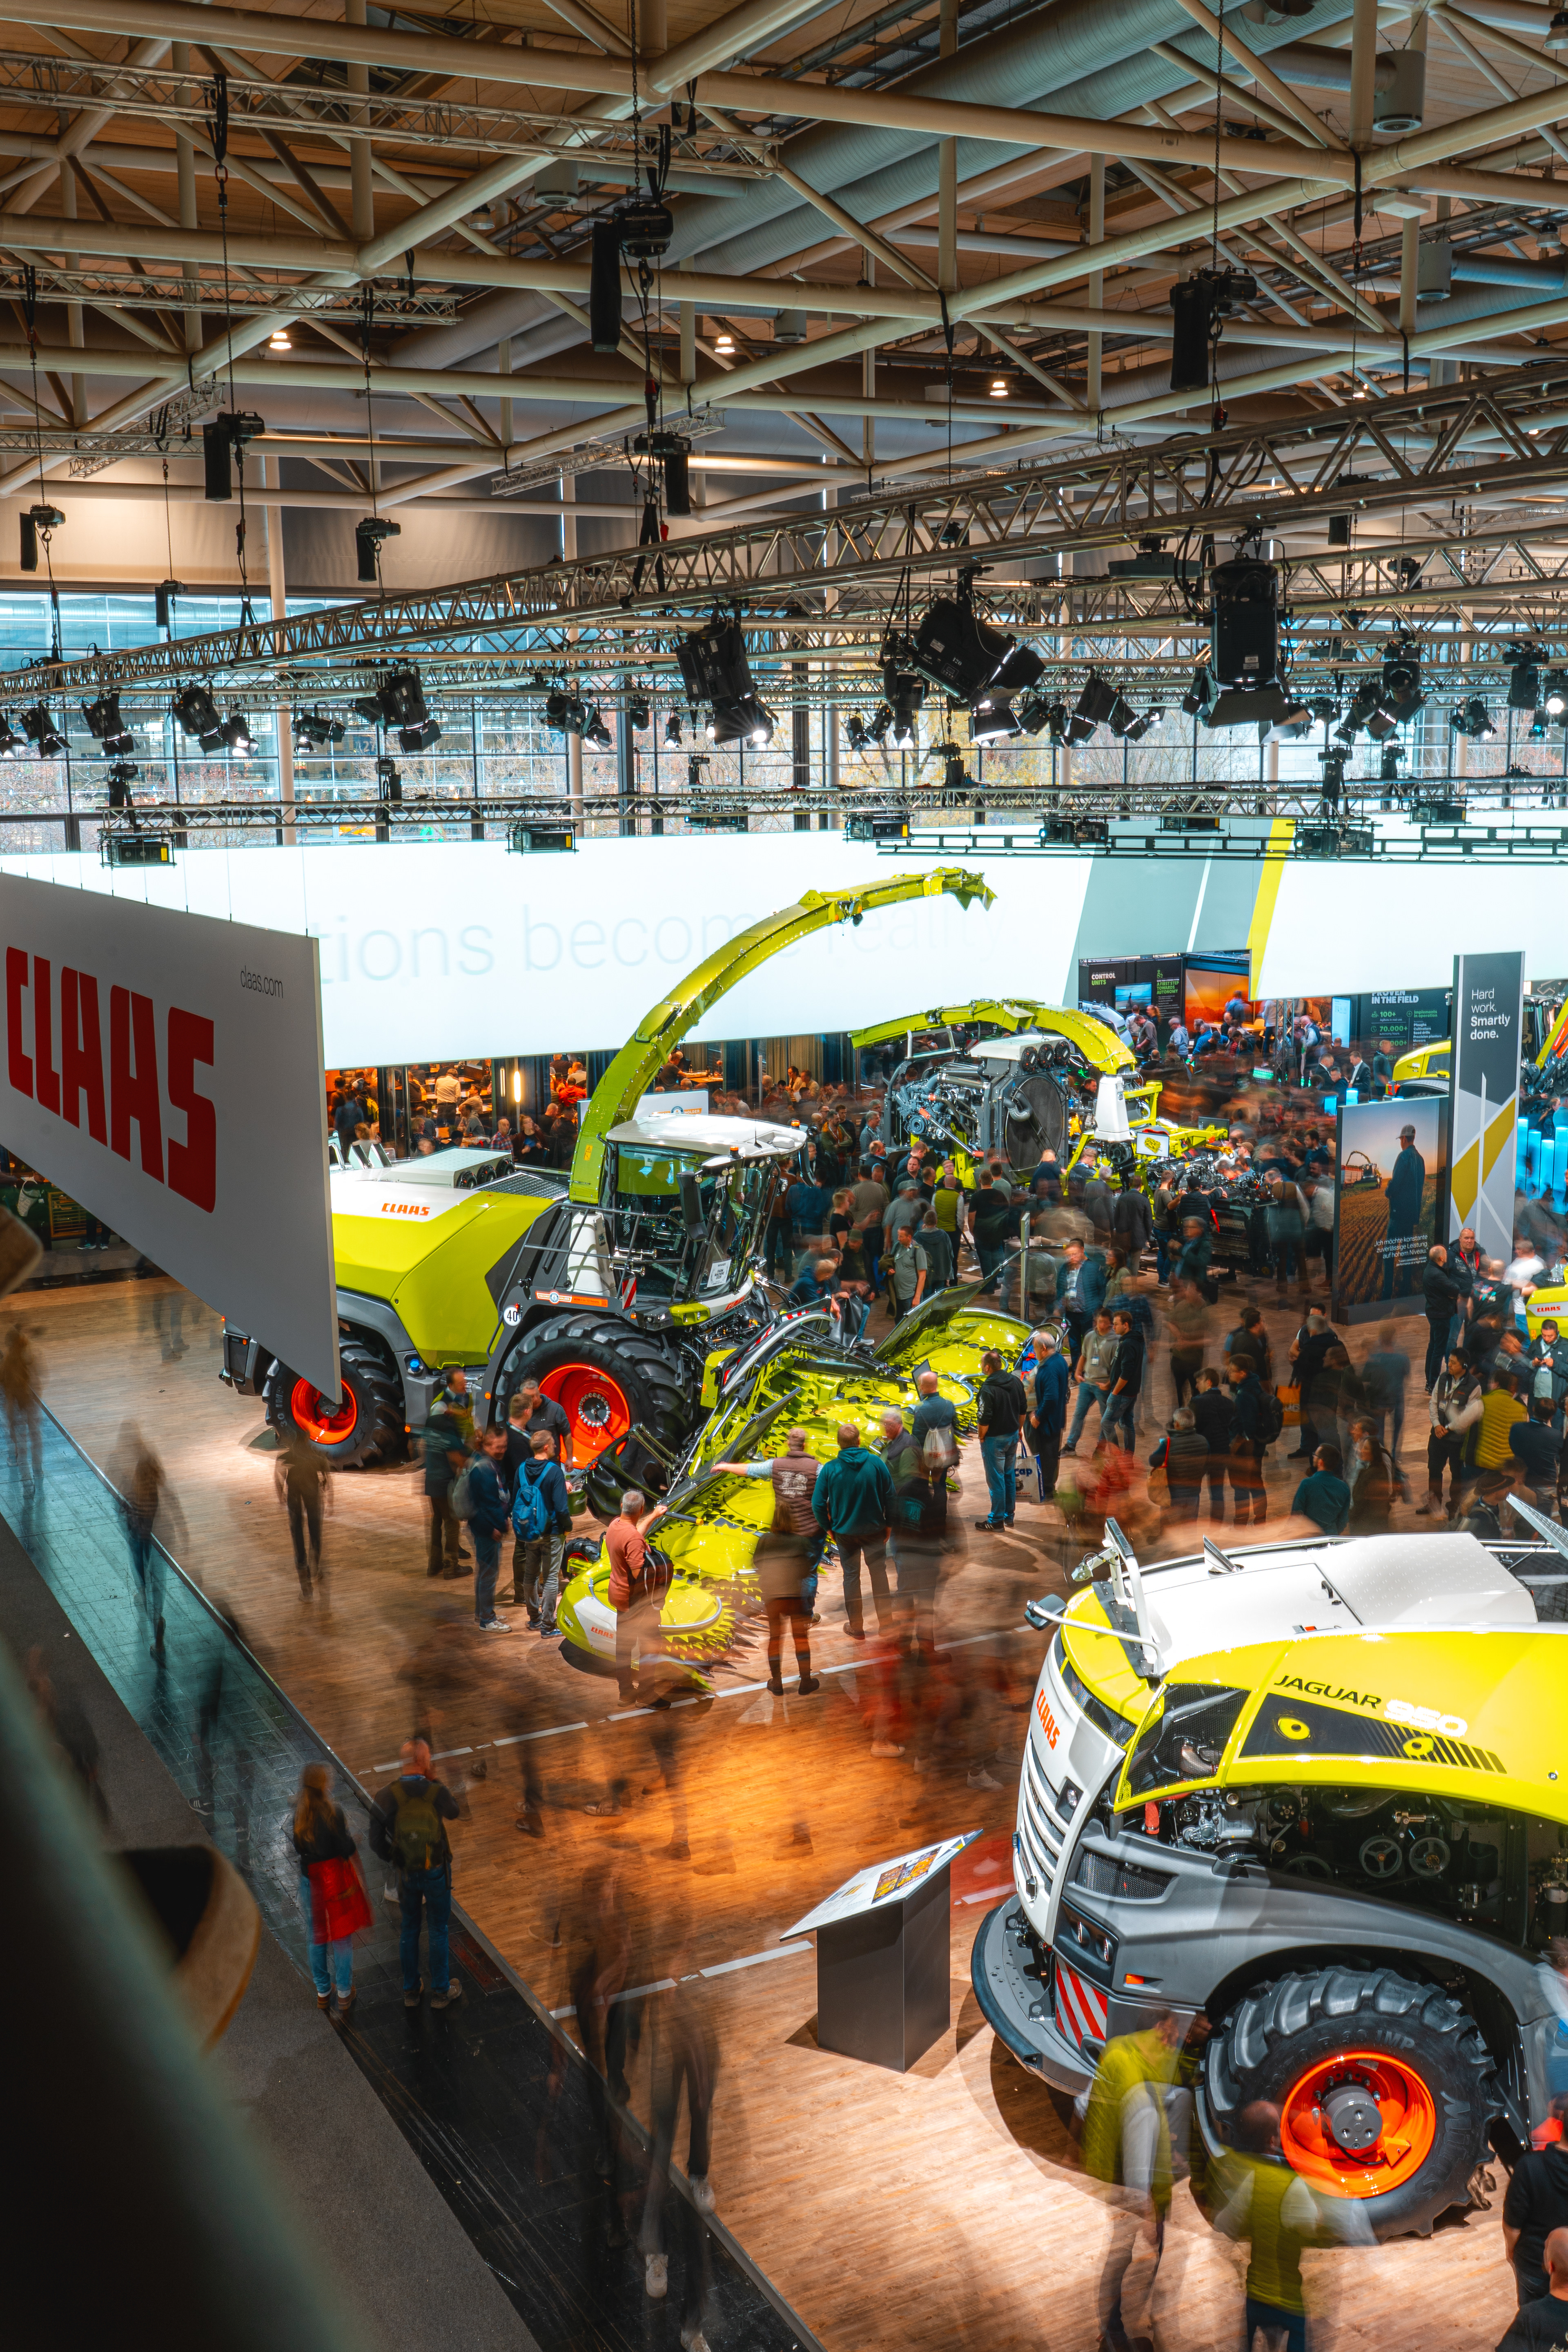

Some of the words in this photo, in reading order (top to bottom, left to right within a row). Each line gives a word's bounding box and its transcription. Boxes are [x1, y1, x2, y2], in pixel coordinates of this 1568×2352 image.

[523, 904, 801, 971] becom
[240, 965, 283, 998] claas.com
[1398, 995, 1419, 1003] FIELD
[1472, 988, 1494, 1000] Hard
[1471, 1001, 1497, 1013] work.
[1471, 1013, 1510, 1027] Smartly
[1470, 1029, 1499, 1040] done.
[6, 946, 216, 1213] CLAAS
[381, 1203, 430, 1216] CLAAS
[1376, 1244, 1406, 1253] zuverlässige
[507, 1310, 517, 1322] 40
[591, 1626, 614, 1639] CLAAS
[1274, 1675, 1381, 1709] JAGUAR
[1384, 1699, 1468, 1738] 950
[1036, 1688, 1060, 1750] CLAAS
[1376, 2029, 1415, 2049] IMP
